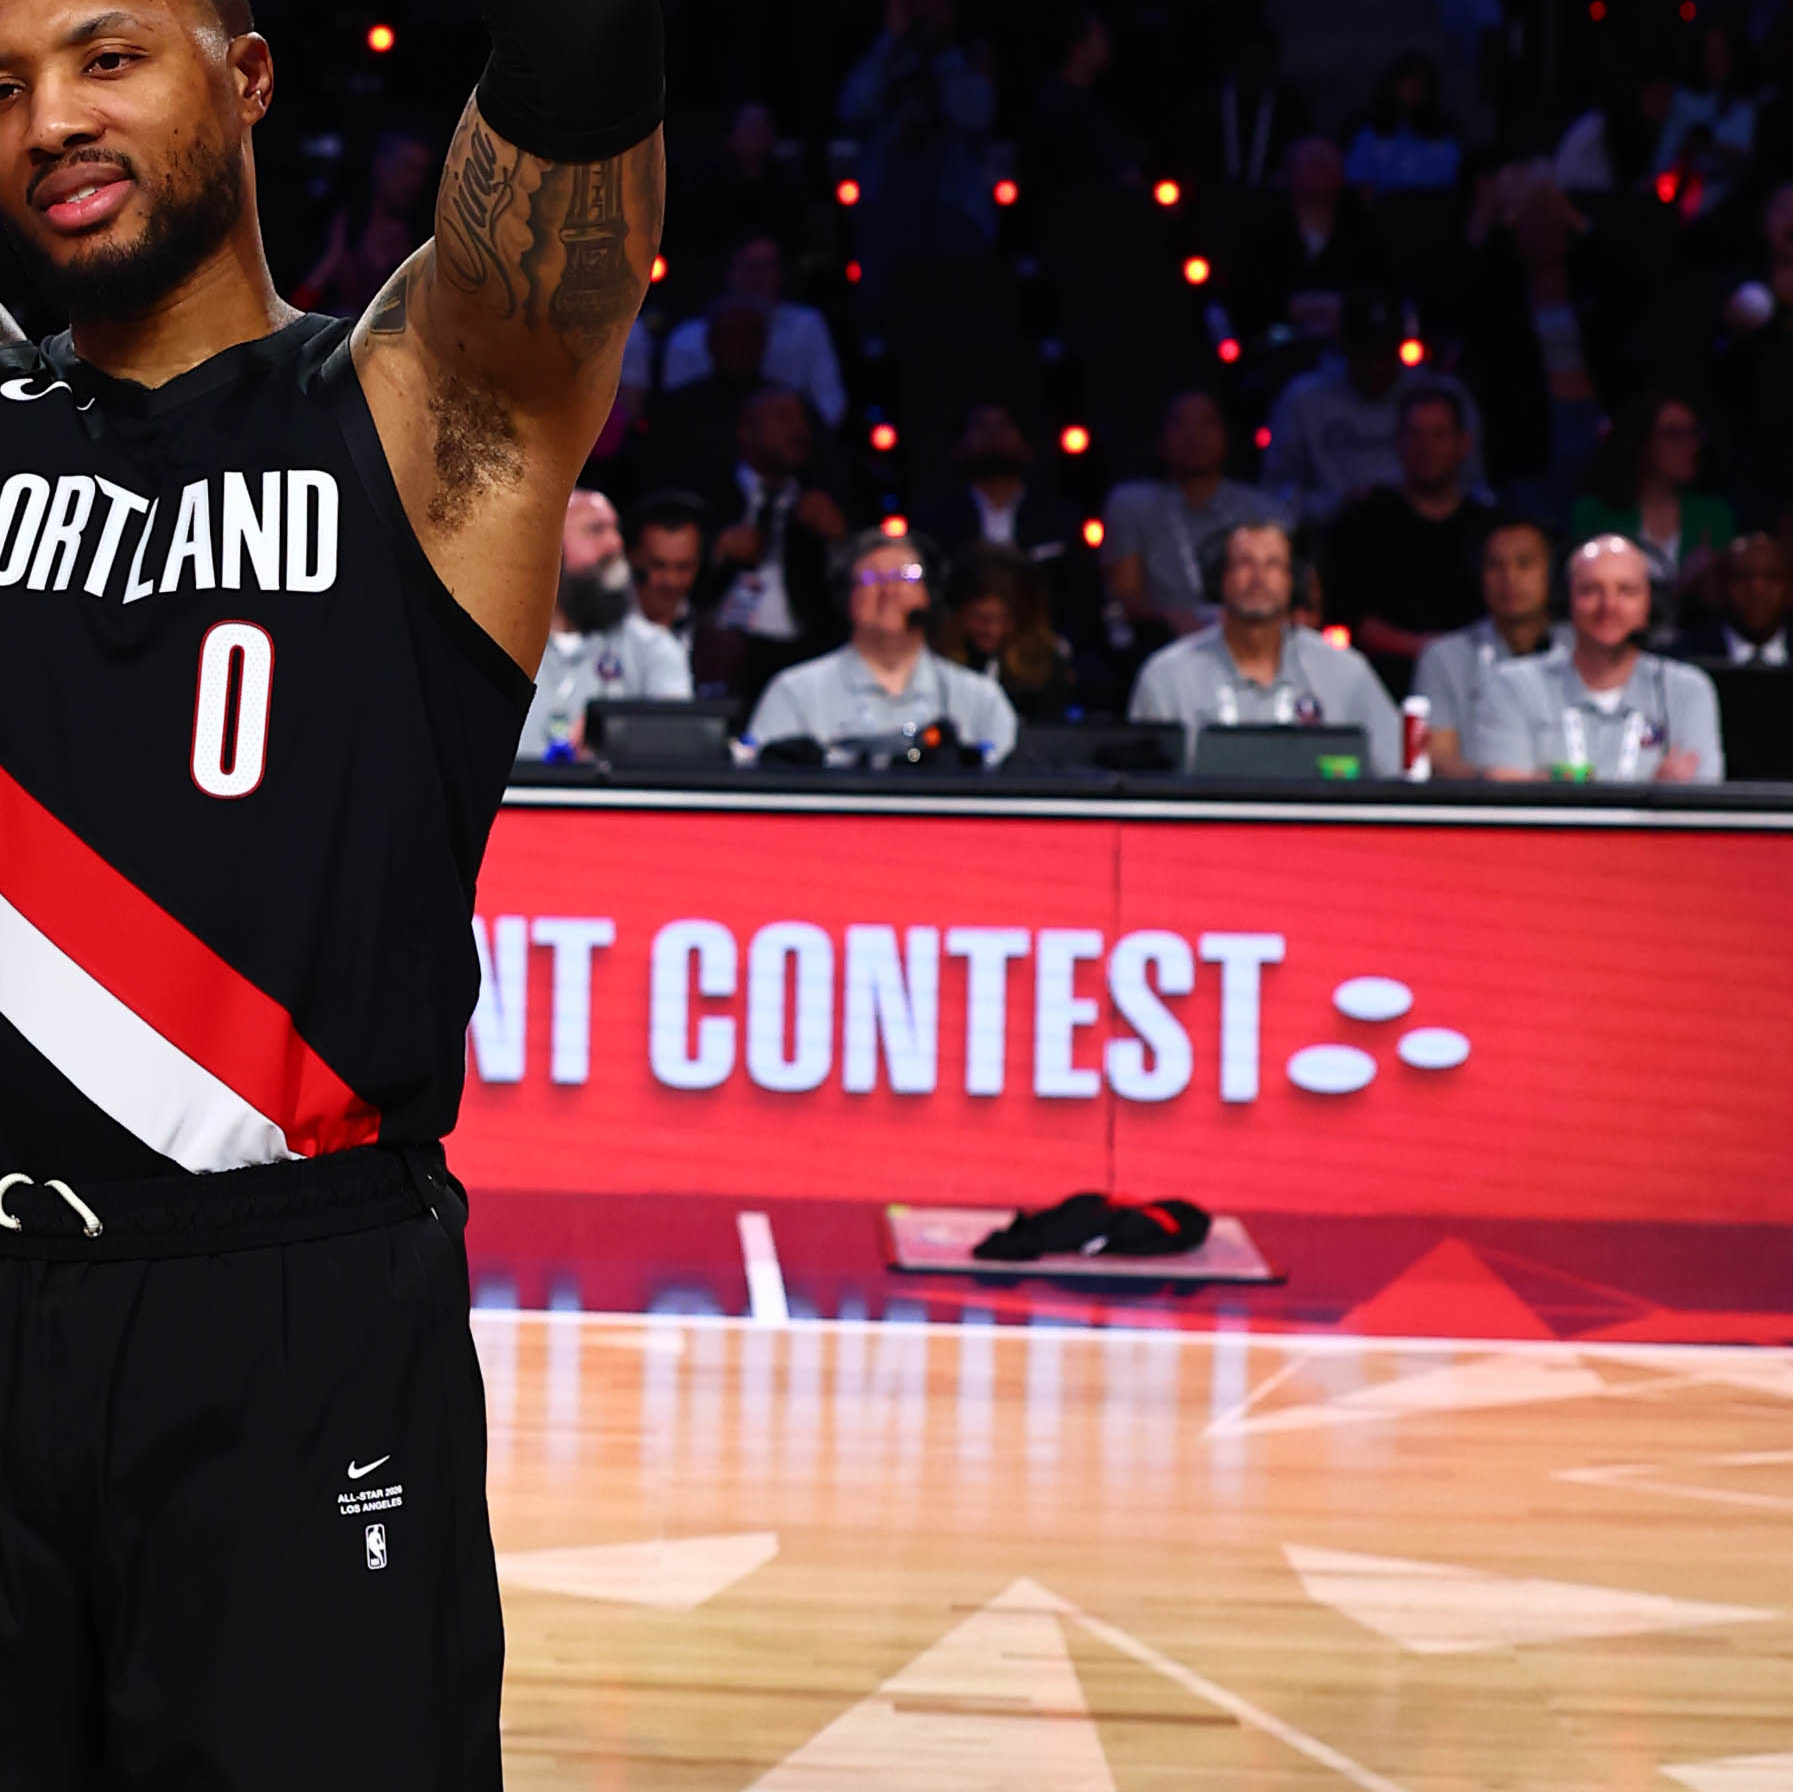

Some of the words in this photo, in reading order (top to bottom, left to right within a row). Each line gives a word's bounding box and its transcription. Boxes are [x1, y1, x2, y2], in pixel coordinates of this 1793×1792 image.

[189, 619, 275, 799] 0
[646, 917, 1287, 1105] CONTEST
[338, 1489, 383, 1503] ALL-STAR
[340, 1504, 361, 1515] LOS
[362, 1497, 402, 1512] ANGELES
